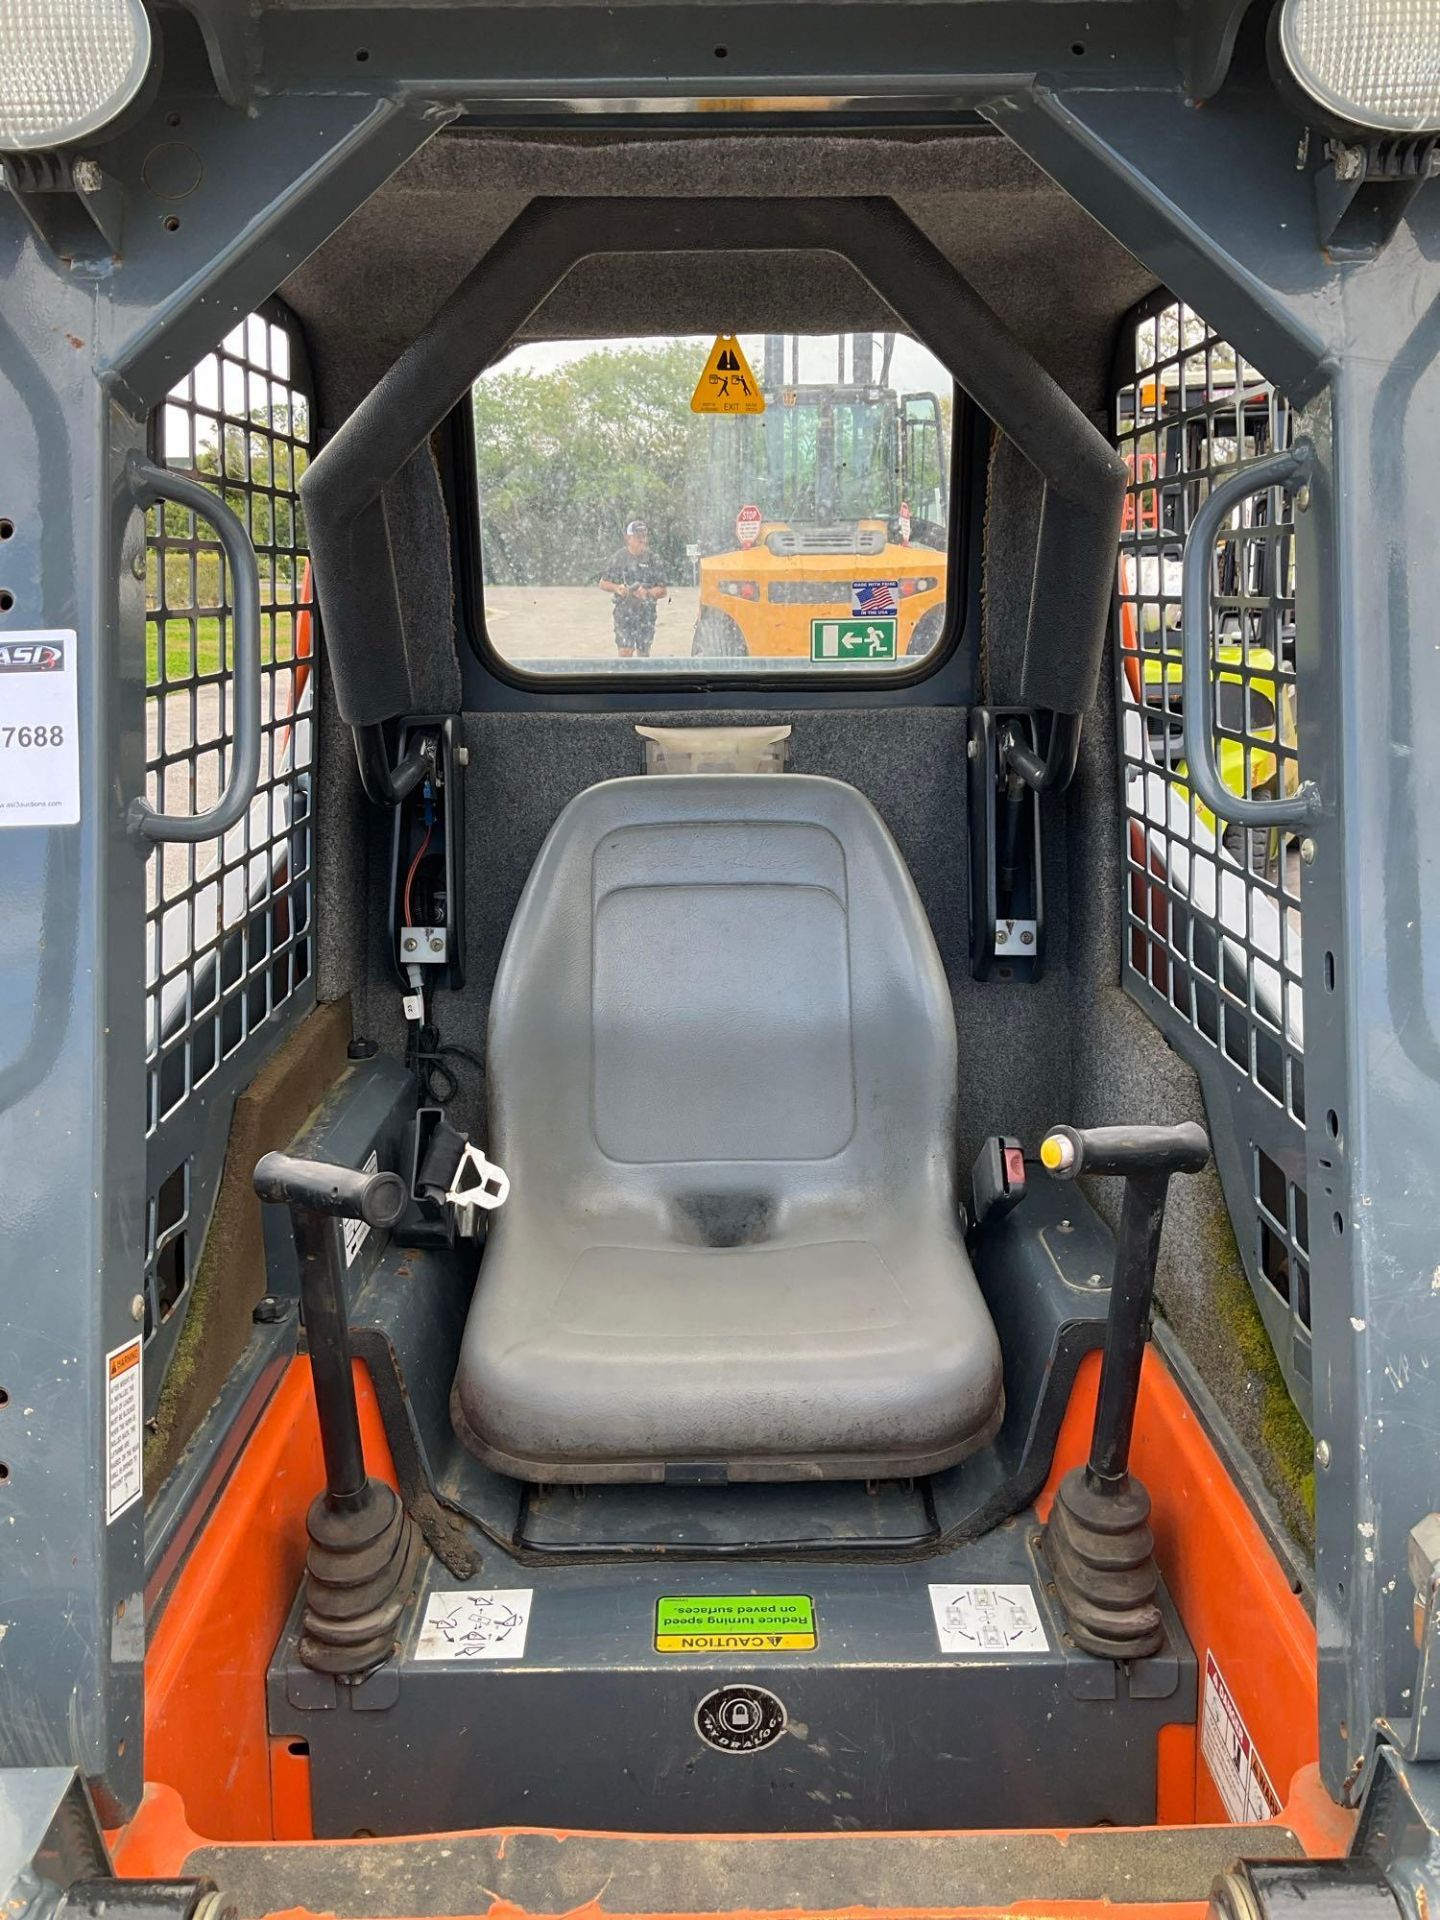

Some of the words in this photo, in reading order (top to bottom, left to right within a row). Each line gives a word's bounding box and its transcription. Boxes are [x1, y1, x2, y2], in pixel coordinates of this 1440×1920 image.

[723, 402, 740, 411] EXIT
[742, 510, 757, 520] STOP
[2, 725, 64, 748] 7688
[674, 1606, 734, 1614] surfaces.
[737, 1605, 777, 1613] paved
[780, 1605, 797, 1613] on
[663, 1617, 704, 1626] speed
[707, 1616, 754, 1625] turning
[758, 1616, 808, 1624] Reduce
[682, 1636, 764, 1648] CAUTION
[1219, 1682, 1244, 1744] DANGER
